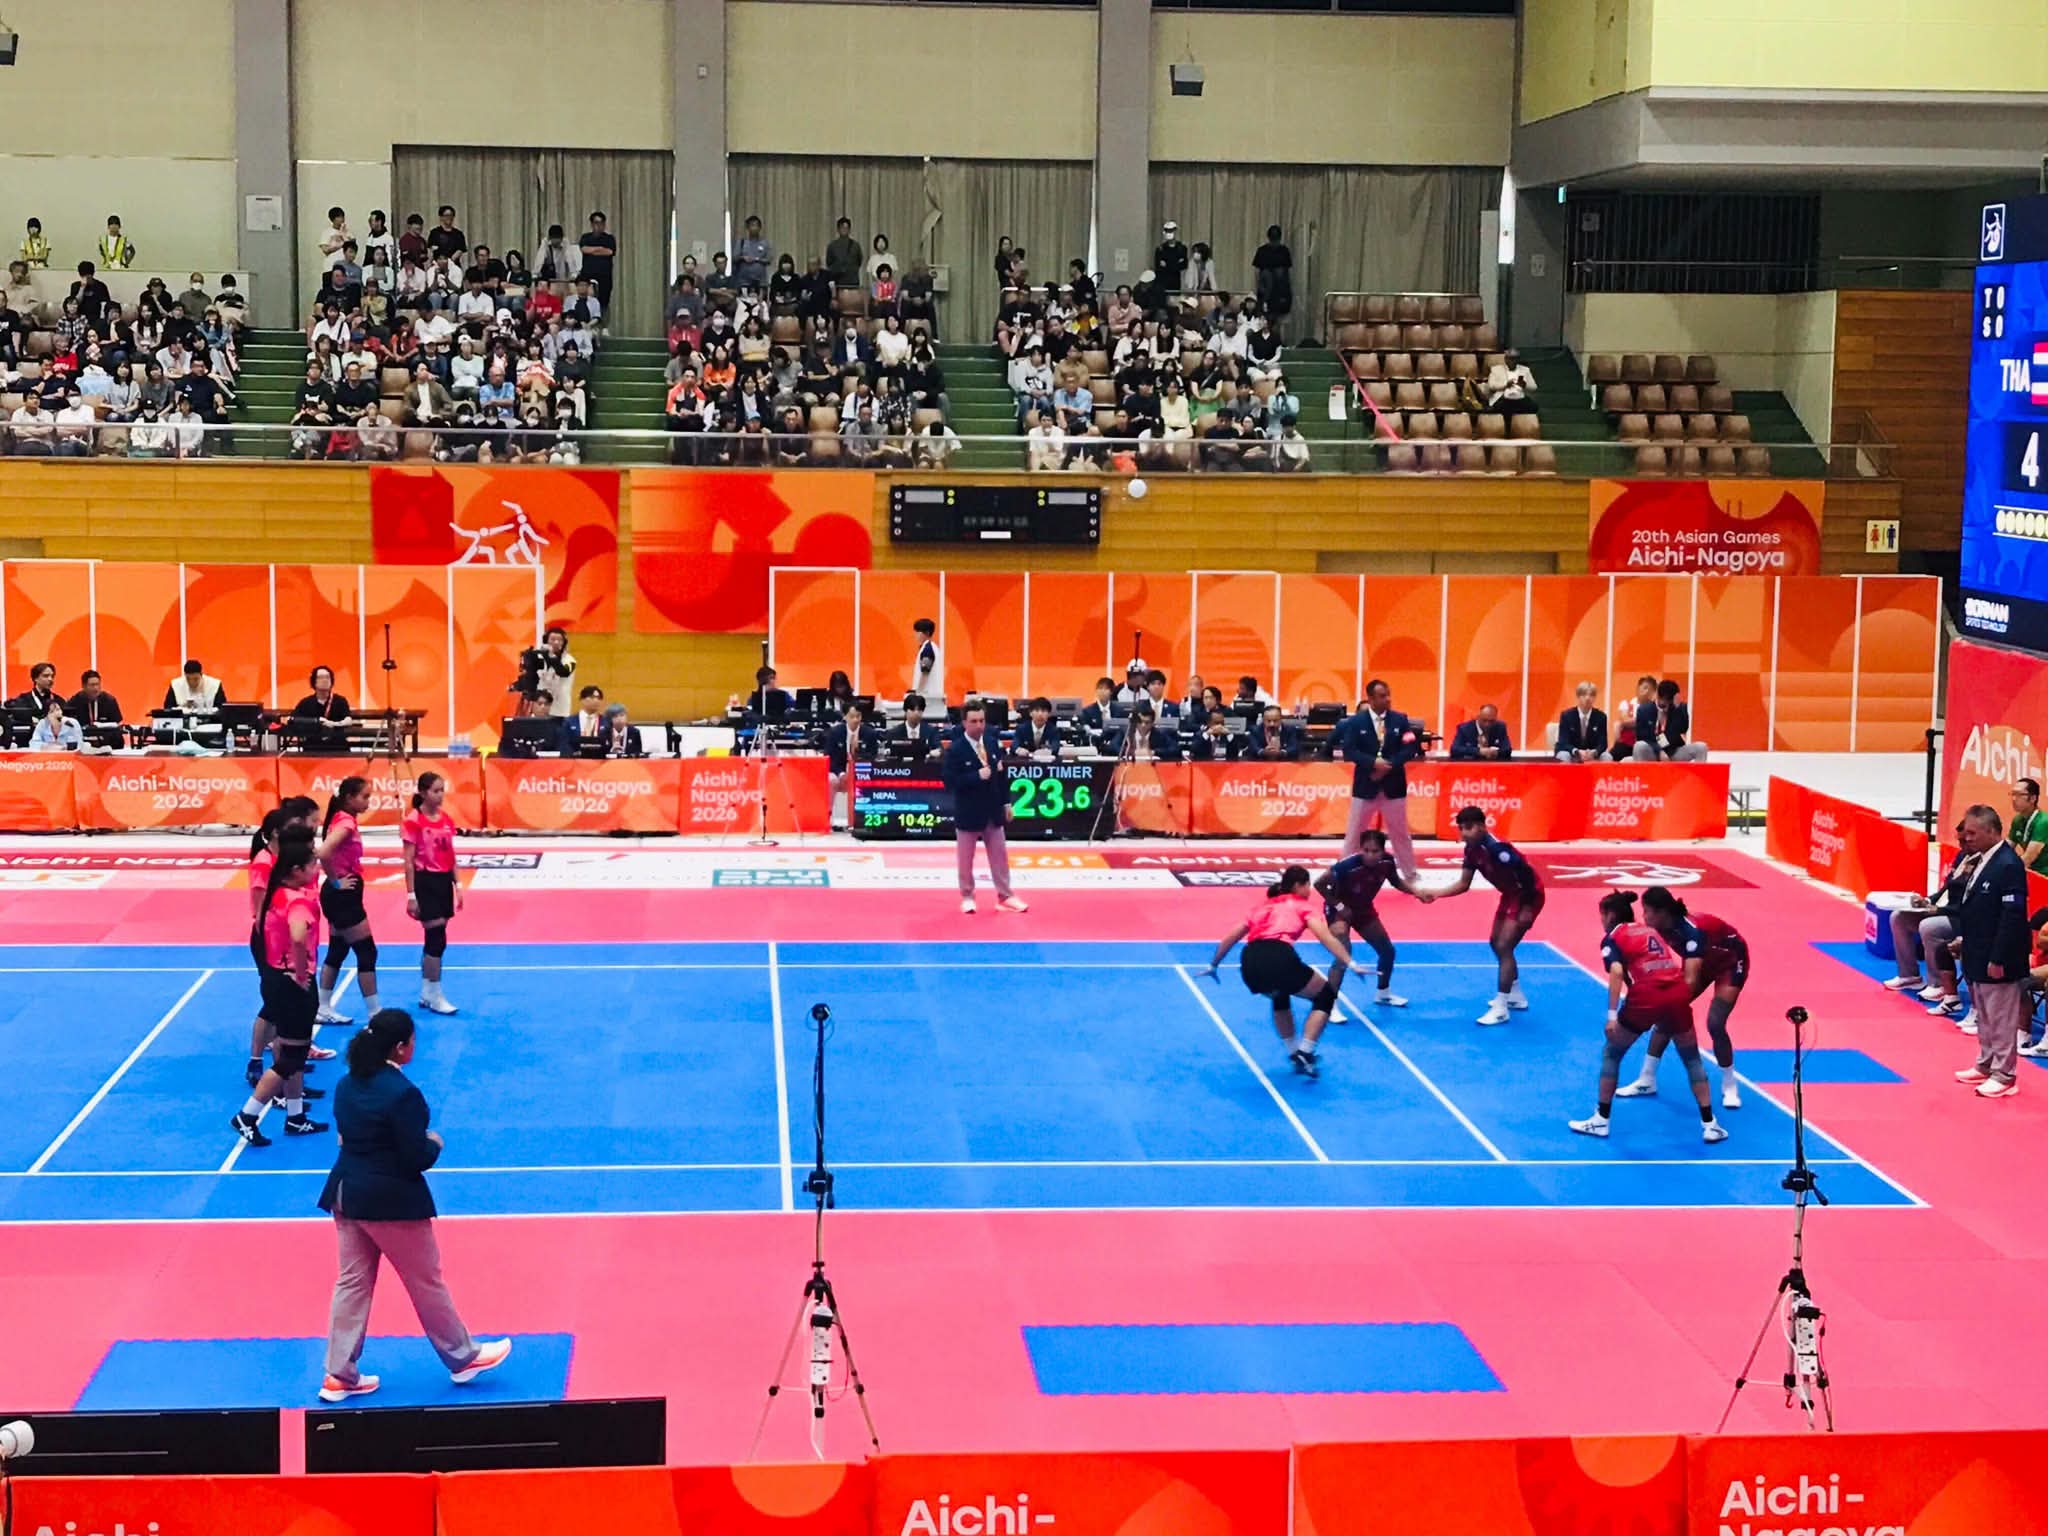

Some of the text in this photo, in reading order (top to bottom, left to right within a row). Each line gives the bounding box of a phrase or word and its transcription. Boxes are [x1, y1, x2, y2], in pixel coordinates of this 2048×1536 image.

[1999, 358, 2031, 393] THA
[2020, 431, 2040, 488] 4
[1631, 530, 1781, 545] 20th Asian Games
[1627, 546, 1785, 571] Aichi-Nagoya
[46, 760, 74, 771] 2026
[1007, 766, 1093, 779] RAID TIMER
[106, 775, 248, 796] Aichi-Nagoya
[517, 776, 653, 797] Aichi-Nagoya
[691, 770, 748, 788] Aichi-
[1450, 778, 1506, 794] Aichi-
[1594, 776, 1649, 793] Aichi-
[691, 788, 763, 806] Nagoya
[1220, 780, 1350, 801] Aichi-Nagoya
[152, 795, 204, 810] 2026
[559, 798, 609, 814] 2026
[1260, 801, 1310, 817] 2026
[1449, 794, 1522, 811] Nagoya
[1593, 794, 1665, 811] Nagoya
[690, 806, 738, 822] 2026
[1593, 812, 1639, 827] 2026
[1719, 1473, 1865, 1518] Aichi-
[901, 1493, 1056, 1536] Aichi-
